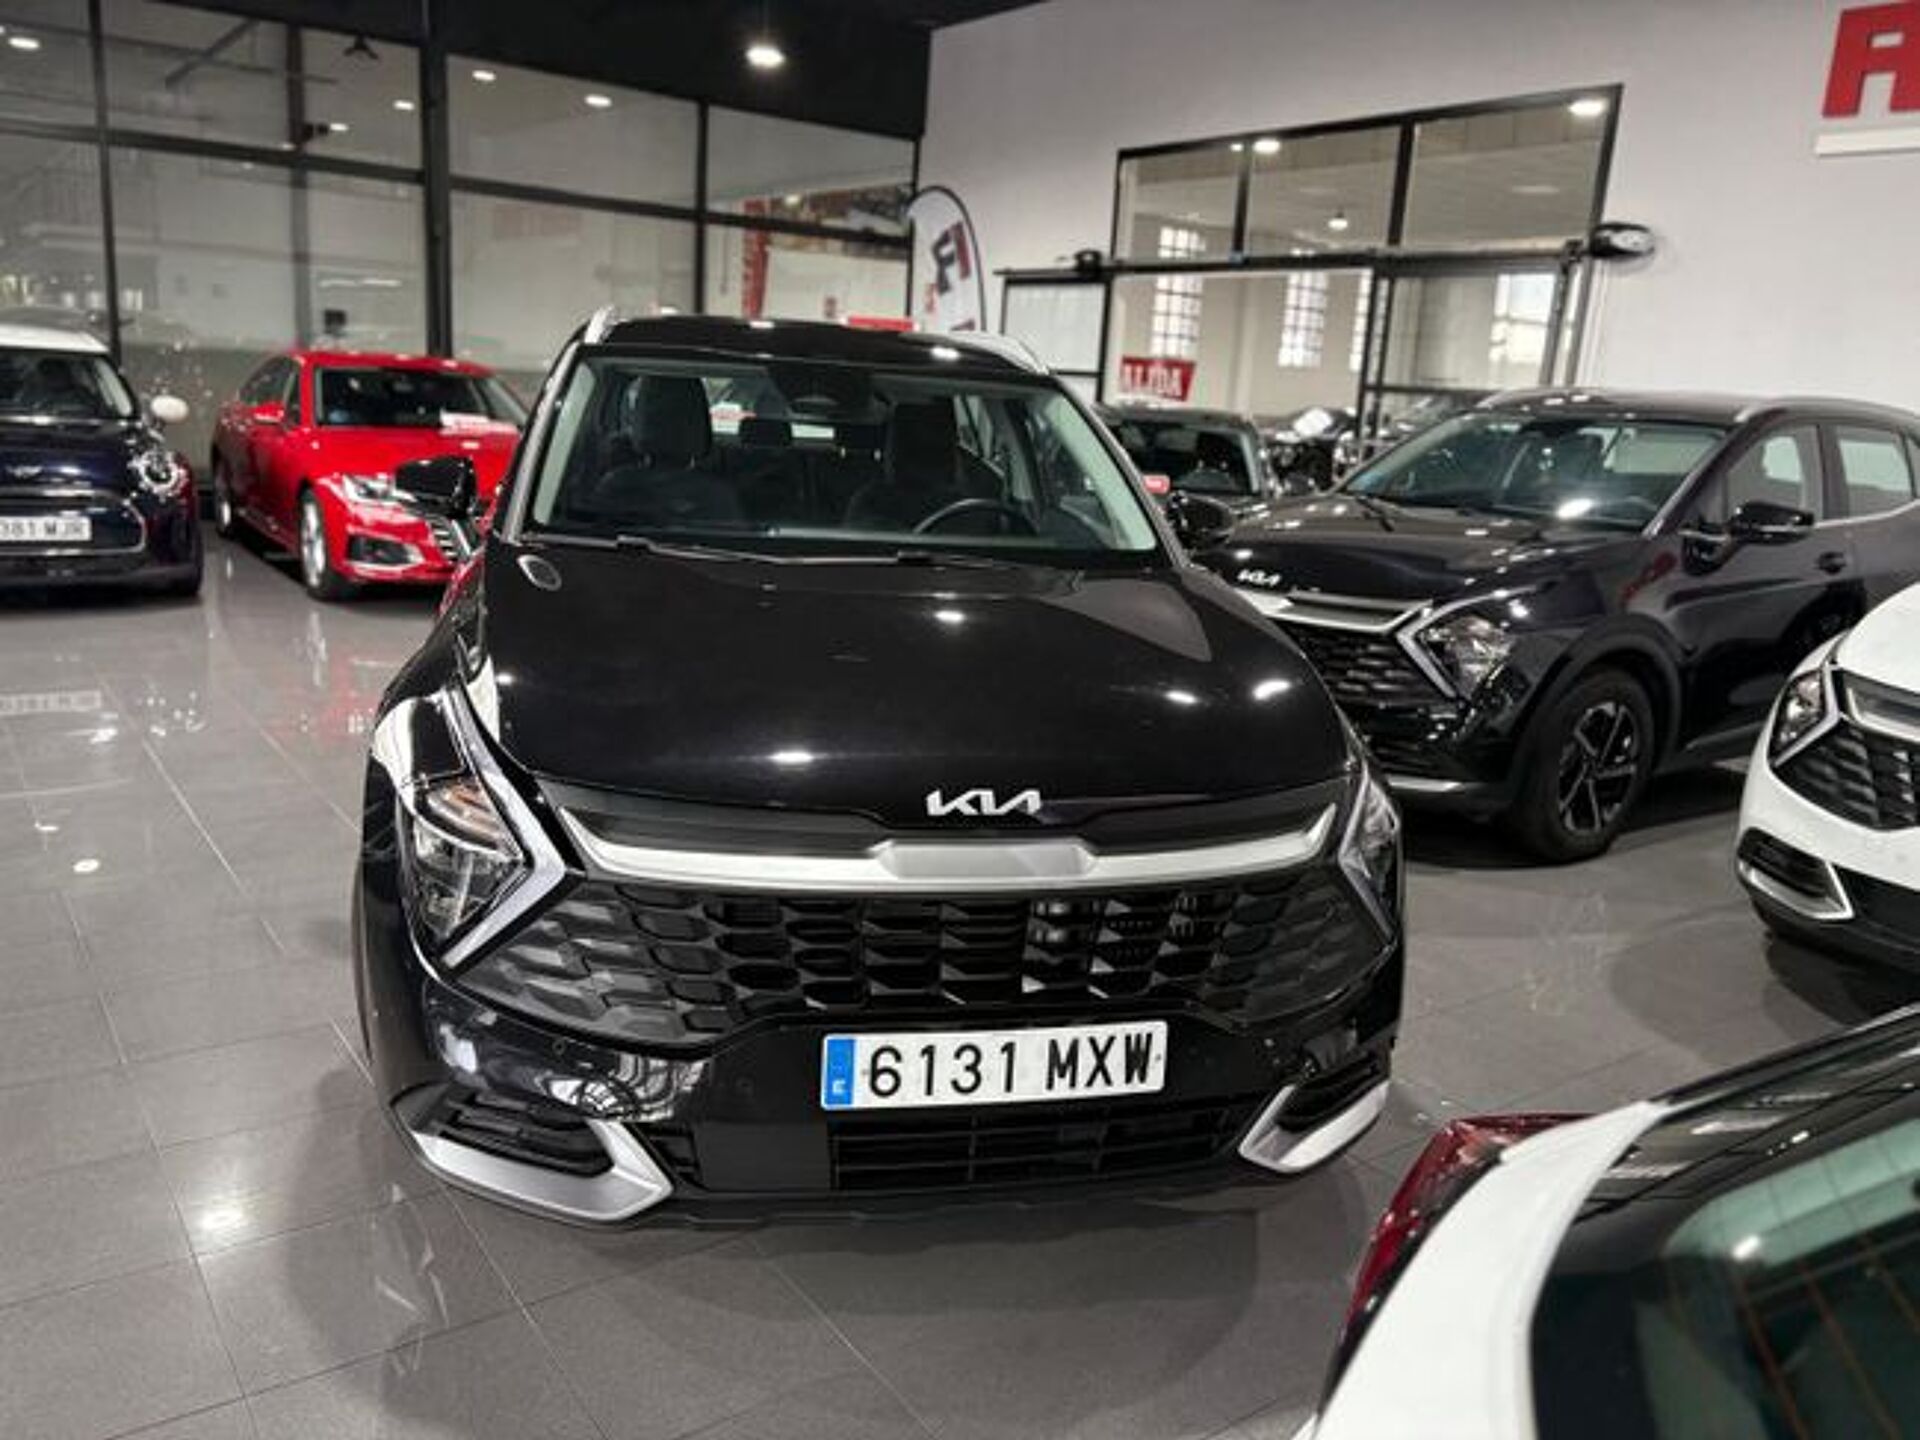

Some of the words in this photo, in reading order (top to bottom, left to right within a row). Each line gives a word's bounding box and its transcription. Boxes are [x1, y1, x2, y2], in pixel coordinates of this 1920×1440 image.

[1238, 569, 1281, 588] KIA
[926, 788, 1041, 816] KIA
[868, 1041, 1016, 1098] 6131
[1045, 1032, 1153, 1091] MXW
